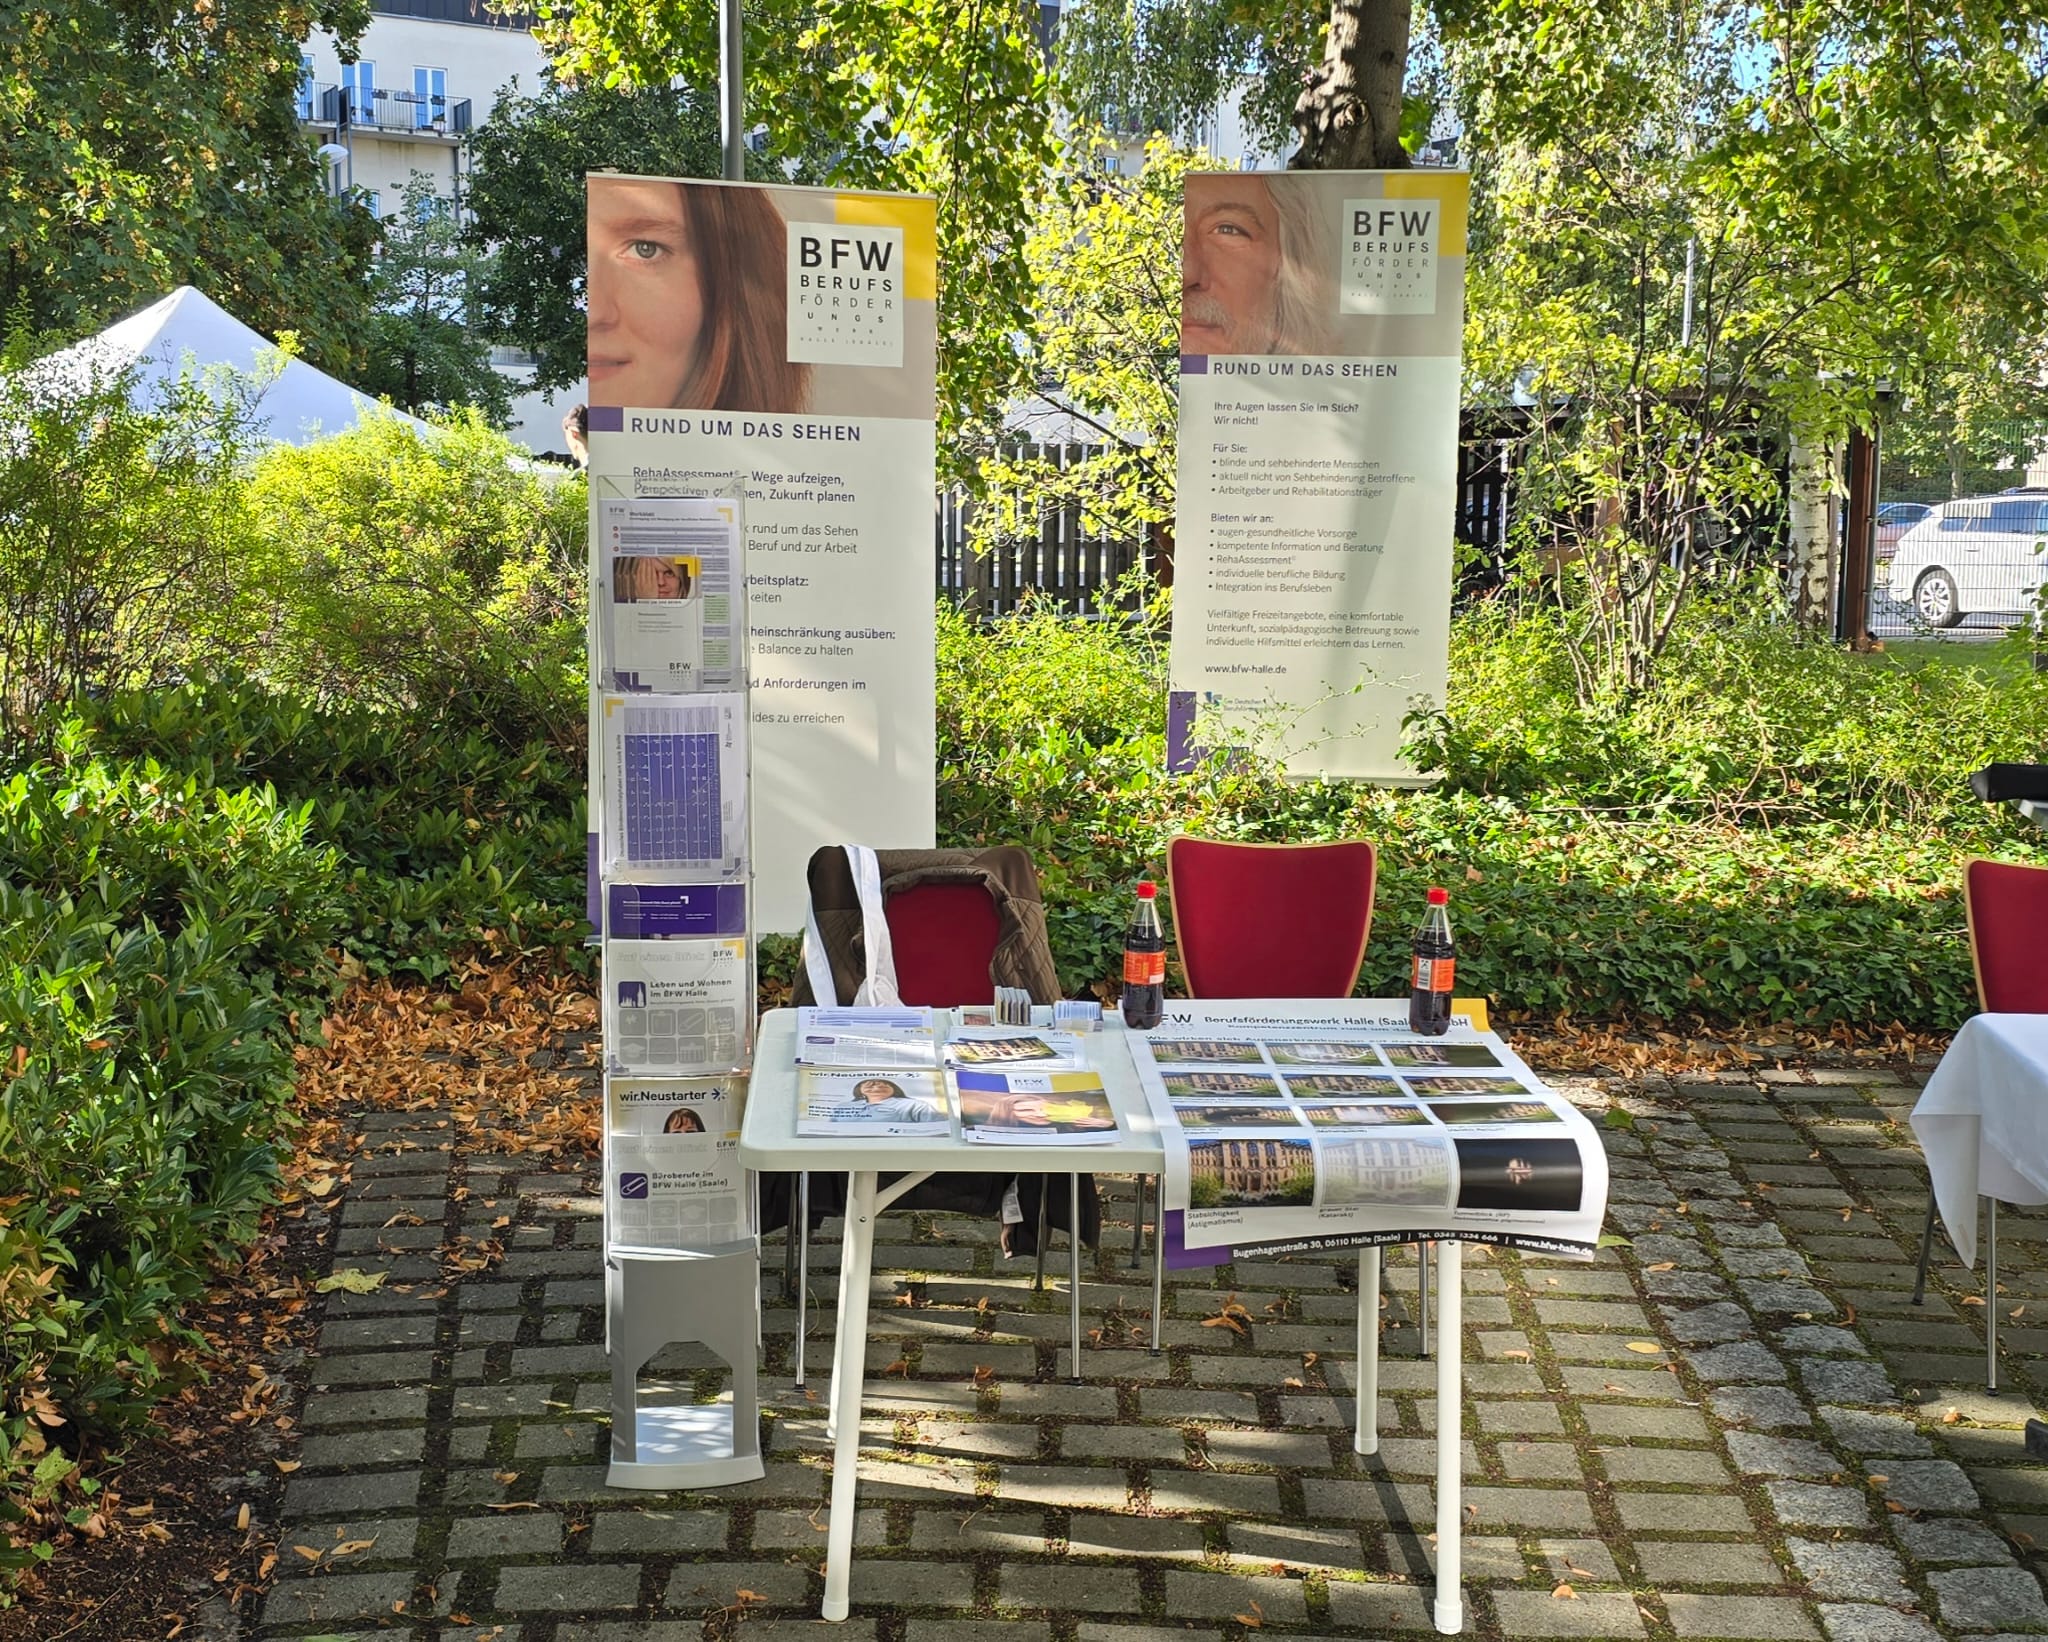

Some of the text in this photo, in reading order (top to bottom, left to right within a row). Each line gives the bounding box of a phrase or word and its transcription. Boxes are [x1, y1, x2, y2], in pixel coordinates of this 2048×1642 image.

[1354, 211, 1431, 236] BFW
[1352, 242, 1429, 253] BERUFS
[800, 236, 893, 272] BFW
[1352, 257, 1429, 268] FÖRDER
[800, 275, 892, 292] BERUFS
[800, 293, 892, 310] FÖRDER
[808, 312, 884, 323] UNGS
[1214, 362, 1398, 377] RUND UM DAS SEHEN
[1214, 402, 1359, 414] Ihre Augen lassen Sie im Stich?
[1214, 416, 1258, 426] Wir nicht!
[632, 417, 861, 441] RUND UM DAS SEHEN
[1214, 444, 1248, 453] Für Sie:
[1219, 458, 1380, 469] blinde und sehbehinderte Menschen
[752, 471, 784, 485] Wege
[787, 472, 845, 487] aufzeigen,
[1219, 472, 1249, 482] aktuell
[1251, 472, 1273, 482] nicht
[1294, 473, 1365, 485] Sehbehinderung
[1368, 474, 1416, 484] Betroffene
[770, 488, 813, 500] Zukunft
[817, 490, 856, 504] planen
[1218, 486, 1383, 499] Arbeitgeber und Rehabilitationsträger
[1211, 513, 1274, 524] Bieten wir an:
[752, 524, 778, 534] rund
[781, 526, 799, 535] um
[802, 524, 821, 535] das
[824, 525, 859, 537] Sehen
[1317, 529, 1358, 540] Vorsorge
[748, 540, 858, 554] Beruf und zur Arbeit
[1217, 542, 1384, 555] kompetente Information und Beratung
[745, 574, 809, 588] rbeitsplatz:
[1216, 569, 1346, 581] individuelle berufliche Bildung
[1215, 583, 1332, 594] Integration ins Berufsleben
[1208, 609, 1404, 622] Vielfältige Freizeitangebote, eine komfortable
[750, 626, 896, 641] heinschränkung ausüben:
[1207, 624, 1420, 637] Unterkunft, sozialpädagogische Betreuung sowie
[758, 643, 854, 656] Balance zu halten
[1206, 638, 1406, 649] individuelle Hilfsmittel erleichtern das Lernen.
[669, 662, 692, 670] BFW
[1205, 665, 1287, 674] www.bfw-halle.de
[764, 678, 848, 692] Anforderungen
[852, 679, 866, 690] im
[778, 714, 790, 723] zu
[793, 713, 845, 724] erreichen
[650, 979, 732, 989] Leben und Wohnen
[664, 990, 683, 998] BFW
[1204, 1016, 1339, 1025] Berufsförderungswerk
[1379, 1017, 1410, 1026] (Saal
[620, 1090, 707, 1102] wir.Neustarter
[674, 1181, 696, 1189] Halle
[699, 1179, 728, 1189] (Saale)
[1188, 1218, 1244, 1229] (Astigmatismus)
[1233, 1242, 1309, 1258] Bugenhagenstraße
[1310, 1240, 1324, 1250] 30,
[1325, 1237, 1350, 1248] 06110
[1351, 1235, 1372, 1245] Halle
[1374, 1233, 1401, 1245] (Saale)
[1516, 1239, 1593, 1257] www.bfw-halle.de
